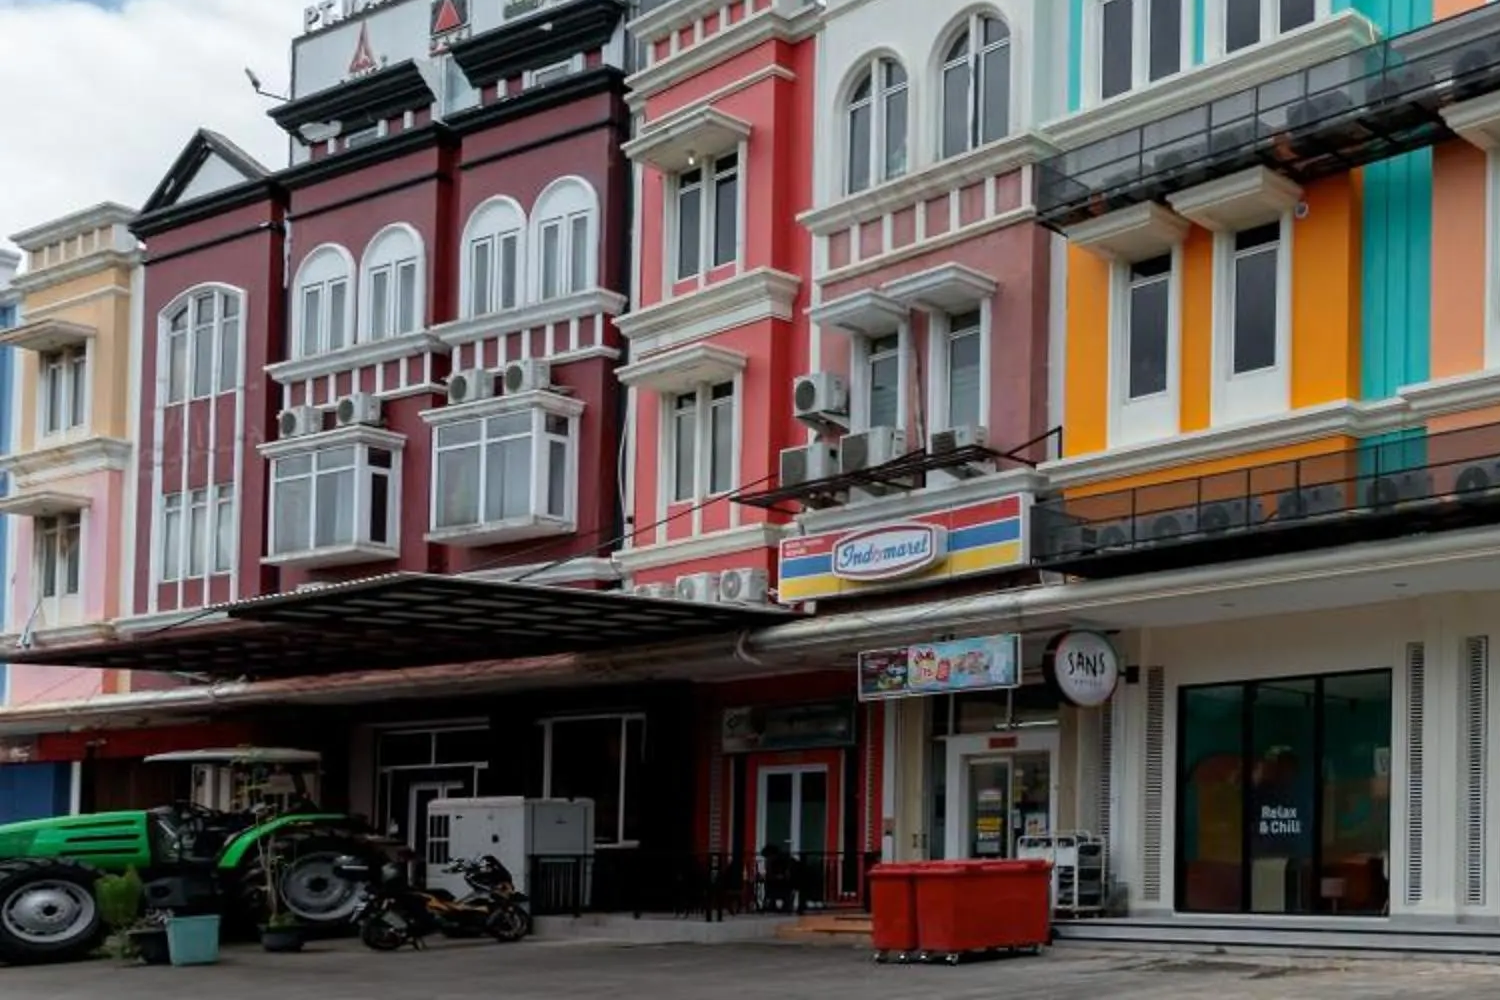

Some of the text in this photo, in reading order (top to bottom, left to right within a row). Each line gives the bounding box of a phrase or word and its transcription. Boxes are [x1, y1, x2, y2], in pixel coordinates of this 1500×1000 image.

[1067, 650, 1106, 678] SANS
[1261, 804, 1298, 819] Relax
[1270, 819, 1302, 834] Chill
